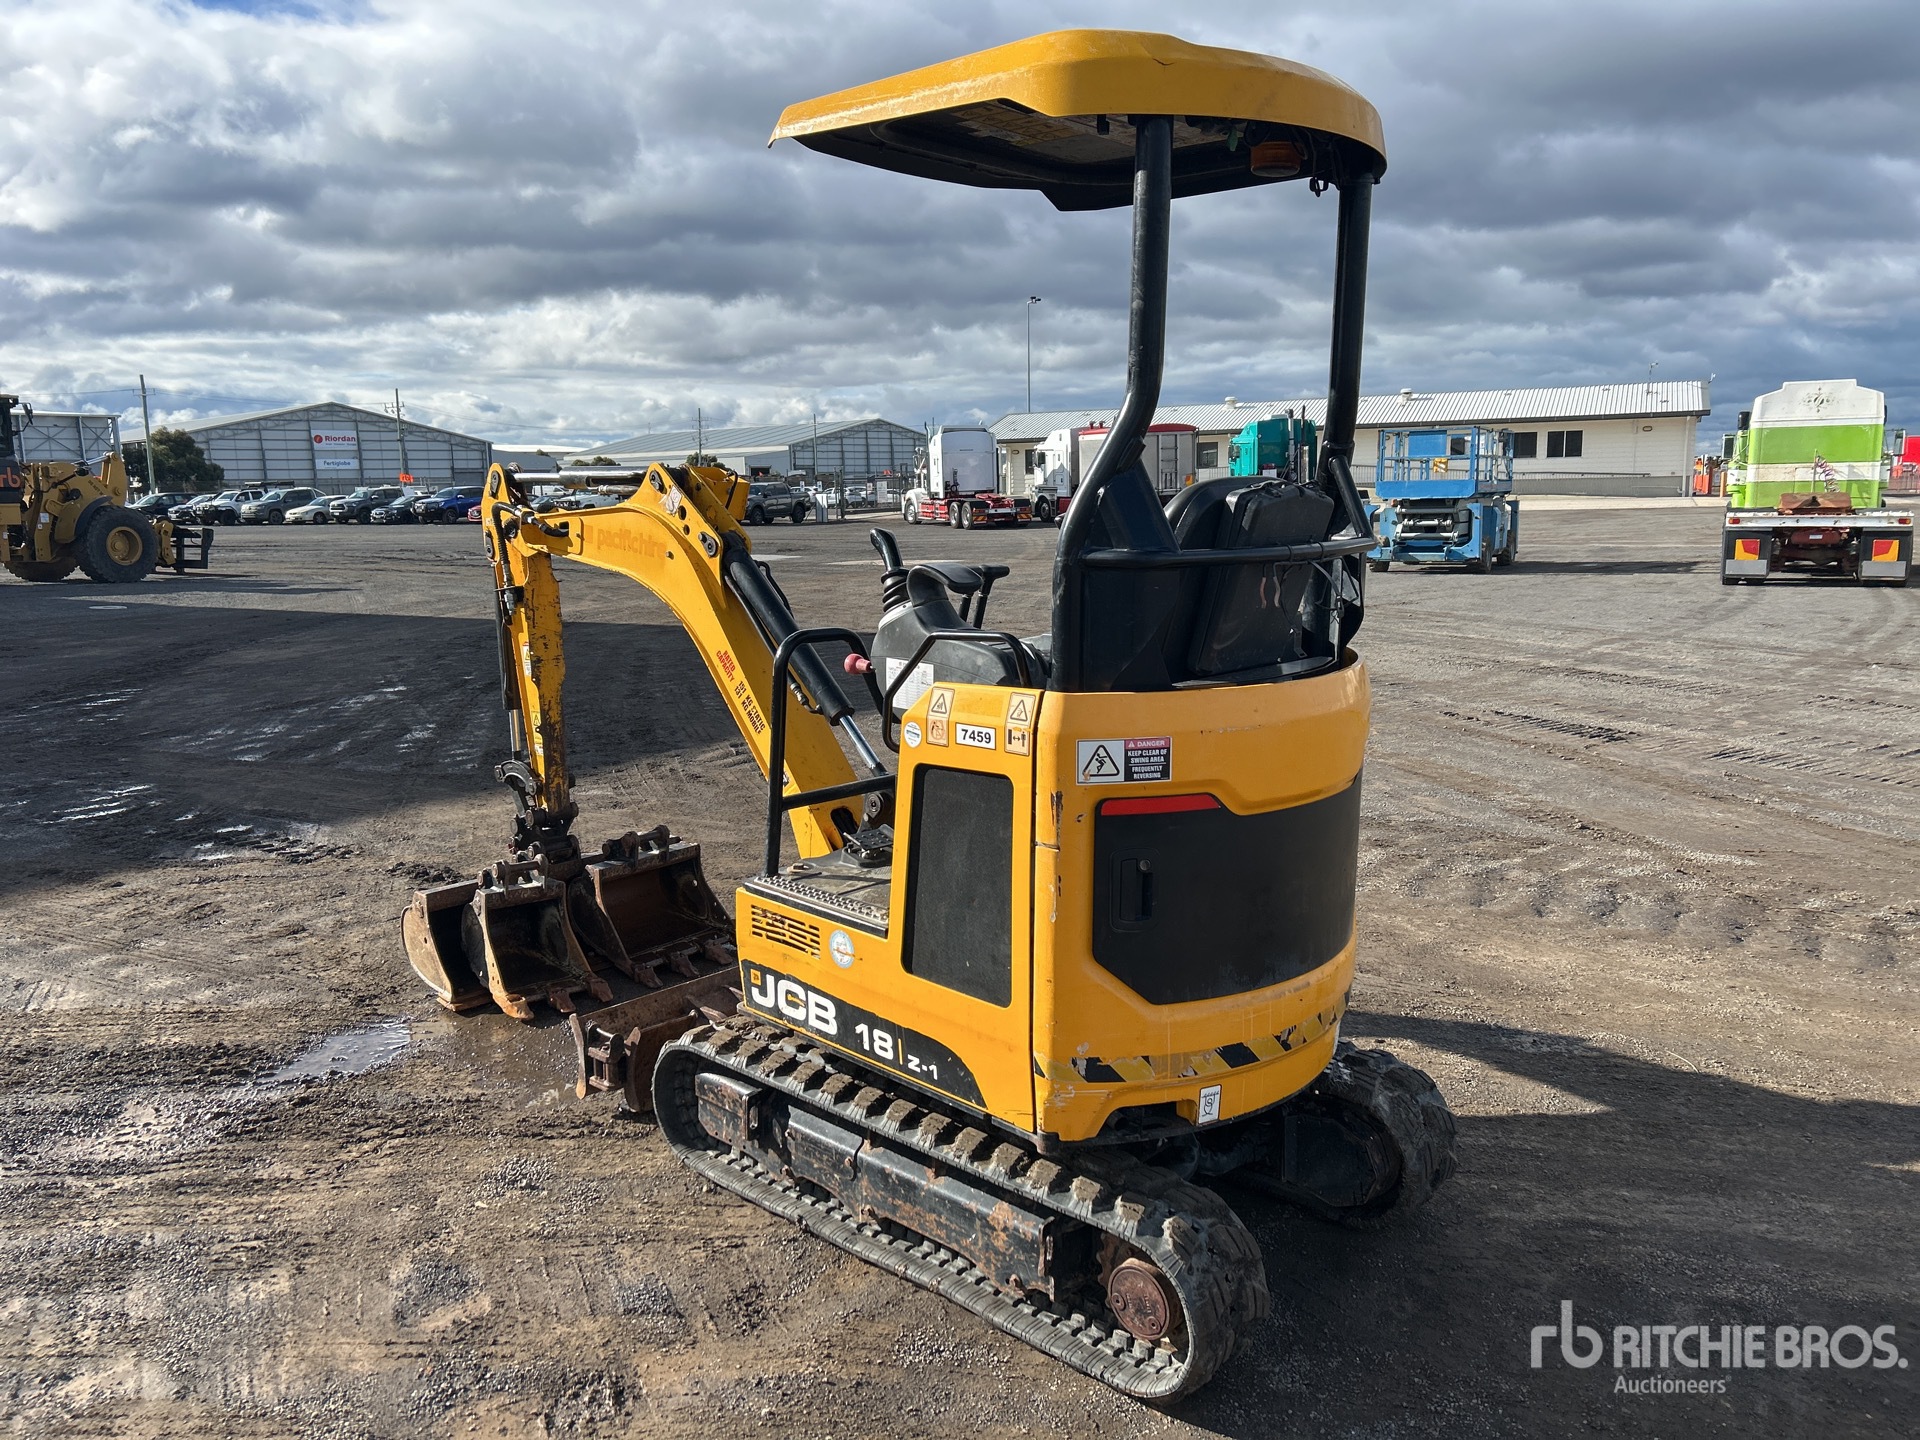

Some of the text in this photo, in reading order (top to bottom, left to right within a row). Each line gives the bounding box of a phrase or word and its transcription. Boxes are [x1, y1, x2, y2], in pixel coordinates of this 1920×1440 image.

[716, 650, 734, 682] CAPACITY
[722, 650, 736, 672] RATED
[745, 694, 754, 707] KG
[961, 728, 992, 744] 7459
[751, 974, 838, 1035] JCB
[854, 1023, 894, 1060] 18
